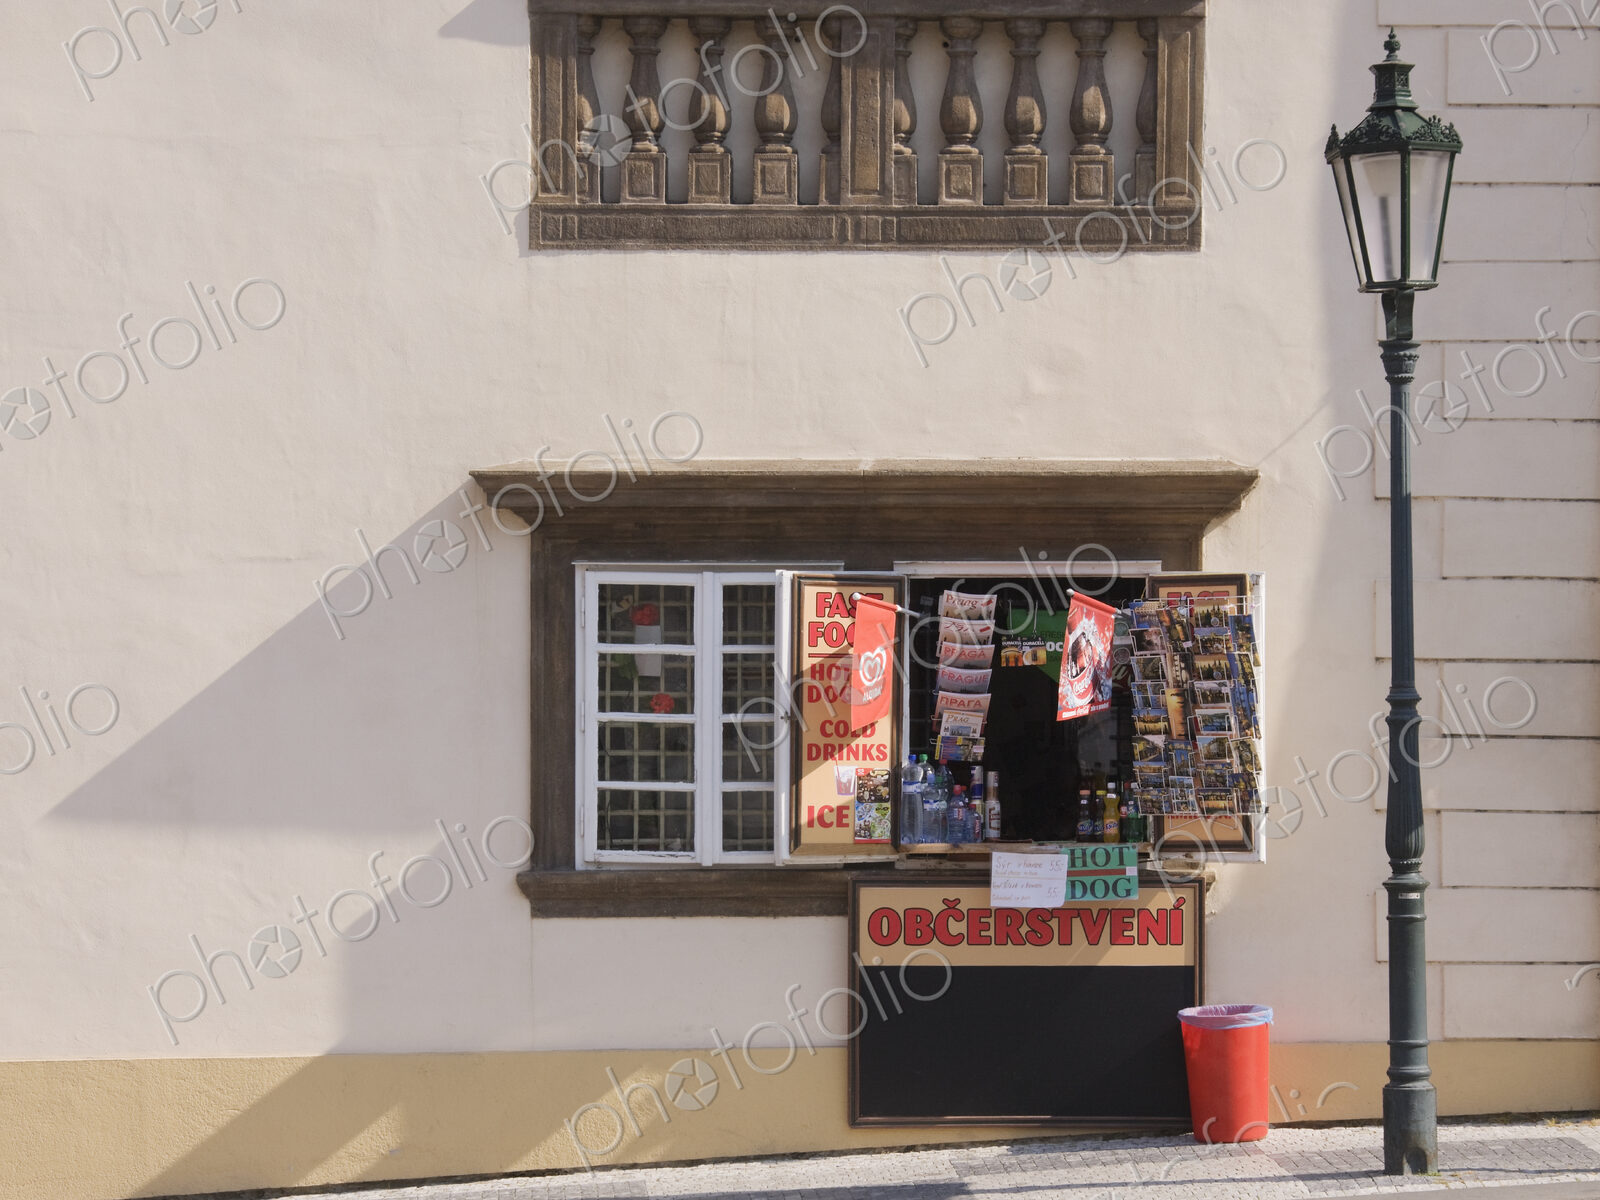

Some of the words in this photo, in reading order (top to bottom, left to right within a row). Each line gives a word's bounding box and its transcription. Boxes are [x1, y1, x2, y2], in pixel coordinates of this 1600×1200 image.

[808, 622, 855, 647] FO
[940, 668, 989, 684] PRAGUE
[940, 695, 983, 709] ПРАГА
[806, 743, 888, 762] DRINKS
[807, 804, 850, 828] ICE
[1068, 846, 1130, 868] HOT
[1068, 877, 1133, 900] DOG
[867, 896, 1186, 946] OBČERSTVENÍ
